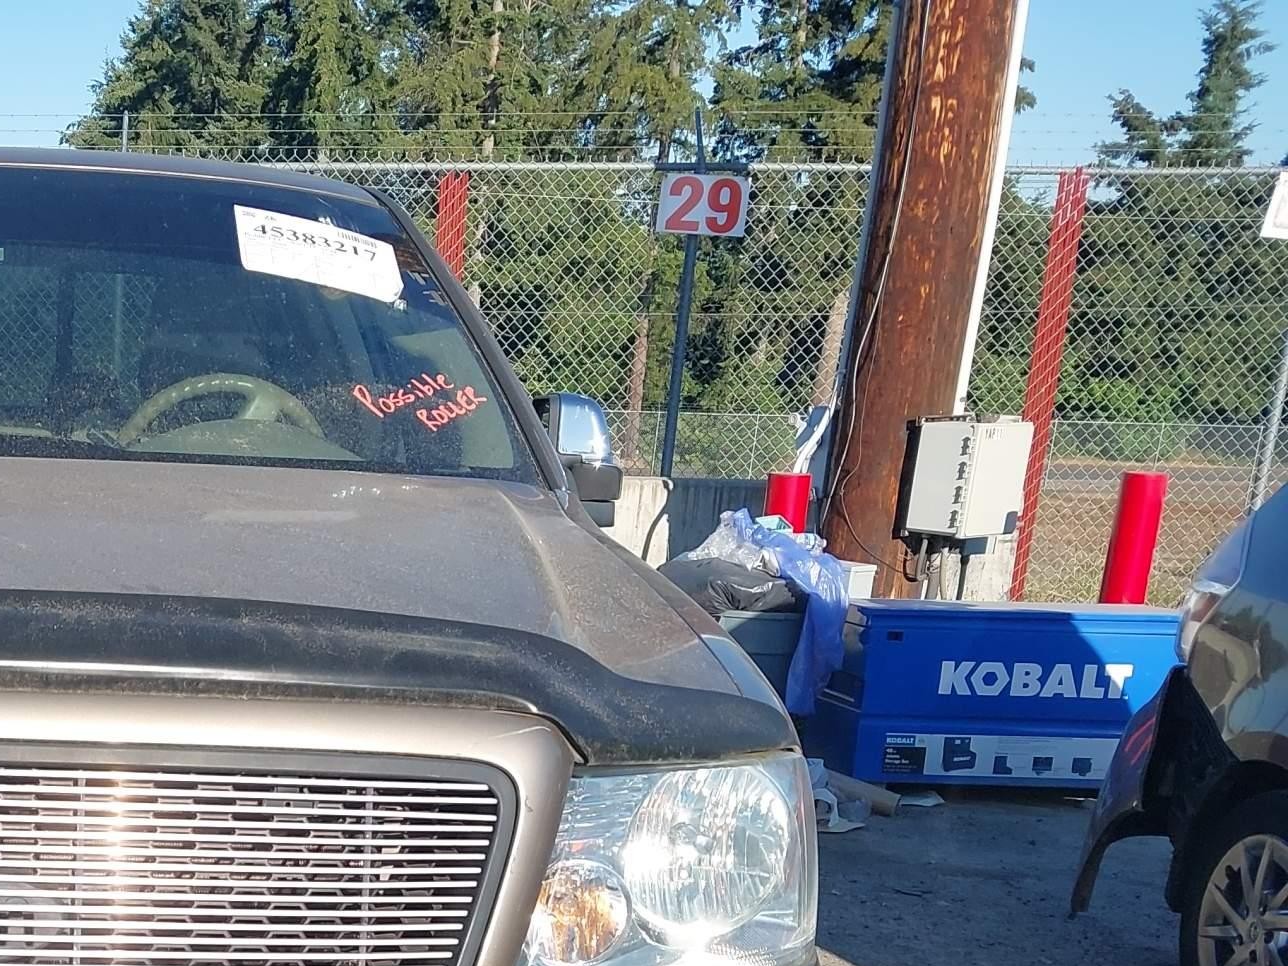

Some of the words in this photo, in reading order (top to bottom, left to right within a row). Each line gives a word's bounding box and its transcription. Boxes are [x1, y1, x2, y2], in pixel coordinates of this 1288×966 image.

[665, 175, 743, 234] 29
[253, 223, 377, 262] 45383217
[352, 372, 455, 419] Possible
[937, 660, 1134, 699] KOBALT
